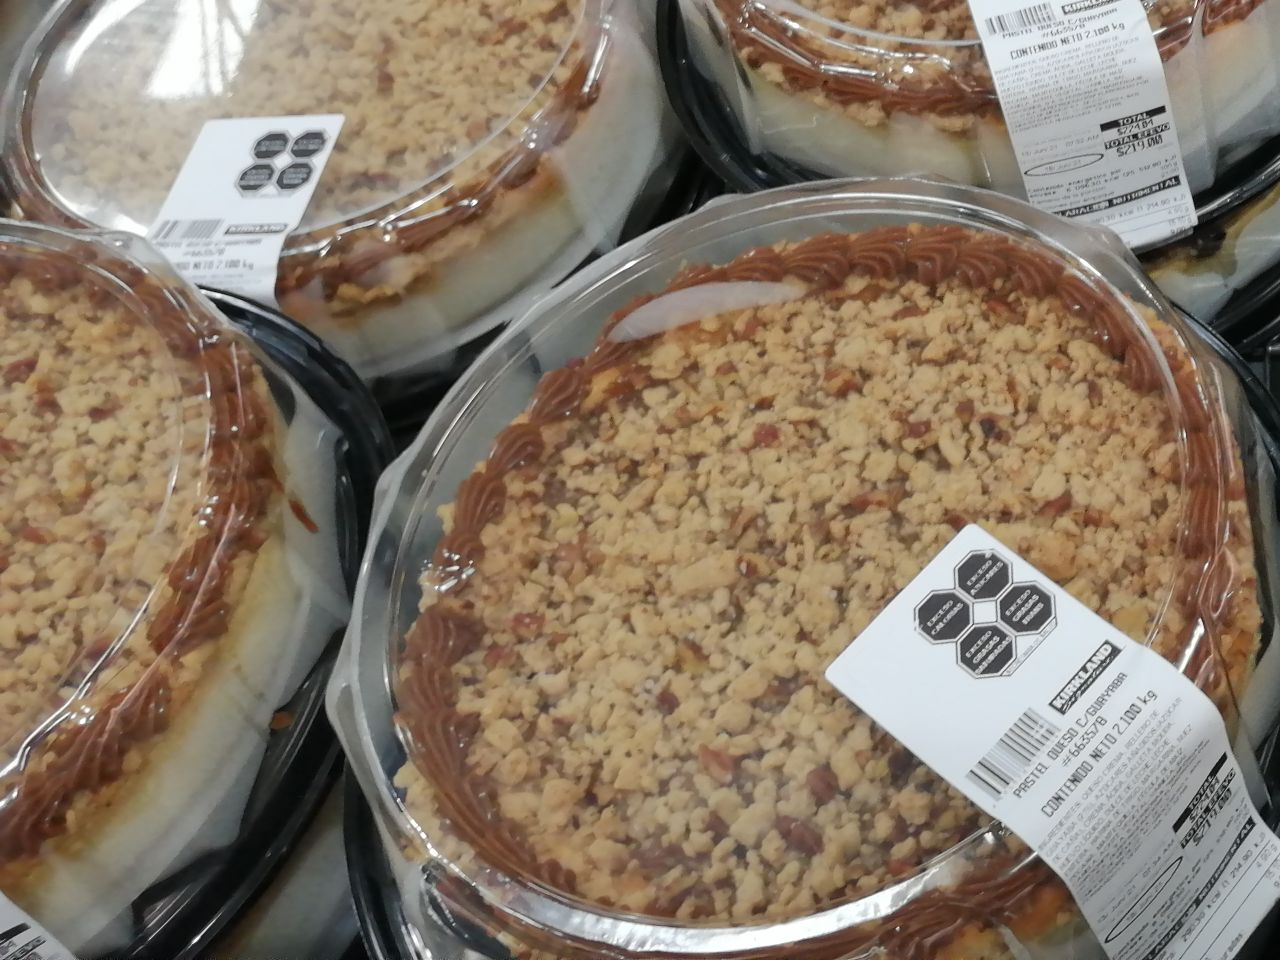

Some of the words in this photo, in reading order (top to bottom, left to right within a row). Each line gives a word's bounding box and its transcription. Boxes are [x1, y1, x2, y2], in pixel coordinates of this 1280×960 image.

[1009, 38, 1058, 60] CONTENIDO
[1060, 31, 1083, 46] NETO
[1111, 21, 1125, 32] kg
[1118, 112, 1149, 126] TOTAL
[1104, 133, 1137, 149] TOTAL
[1115, 134, 1163, 157] $219.00
[965, 558, 993, 587] EXCESO
[926, 598, 954, 627] EXCESO
[1004, 588, 1032, 617] EXCESO
[1011, 592, 1040, 622] GRASAS
[1021, 601, 1044, 625] TRANS
[930, 601, 964, 636] CALORIAS
[965, 629, 993, 658] EXCESO
[971, 634, 1000, 664] GRASAS
[1051, 642, 1114, 710] KIRKLAND
[1012, 759, 1049, 799] PASTEL
[1046, 726, 1079, 761] QUESO
[1075, 670, 1128, 729] C/GUAYABA
[1057, 713, 1108, 767] #663578
[1040, 758, 1094, 819] CONTENIDO
[1089, 730, 1117, 764] NETO
[1111, 701, 1142, 736] 2.100
[1137, 686, 1158, 707] kg
[1188, 775, 1214, 809] TOTAL
[1179, 810, 1208, 846] TOTAL
